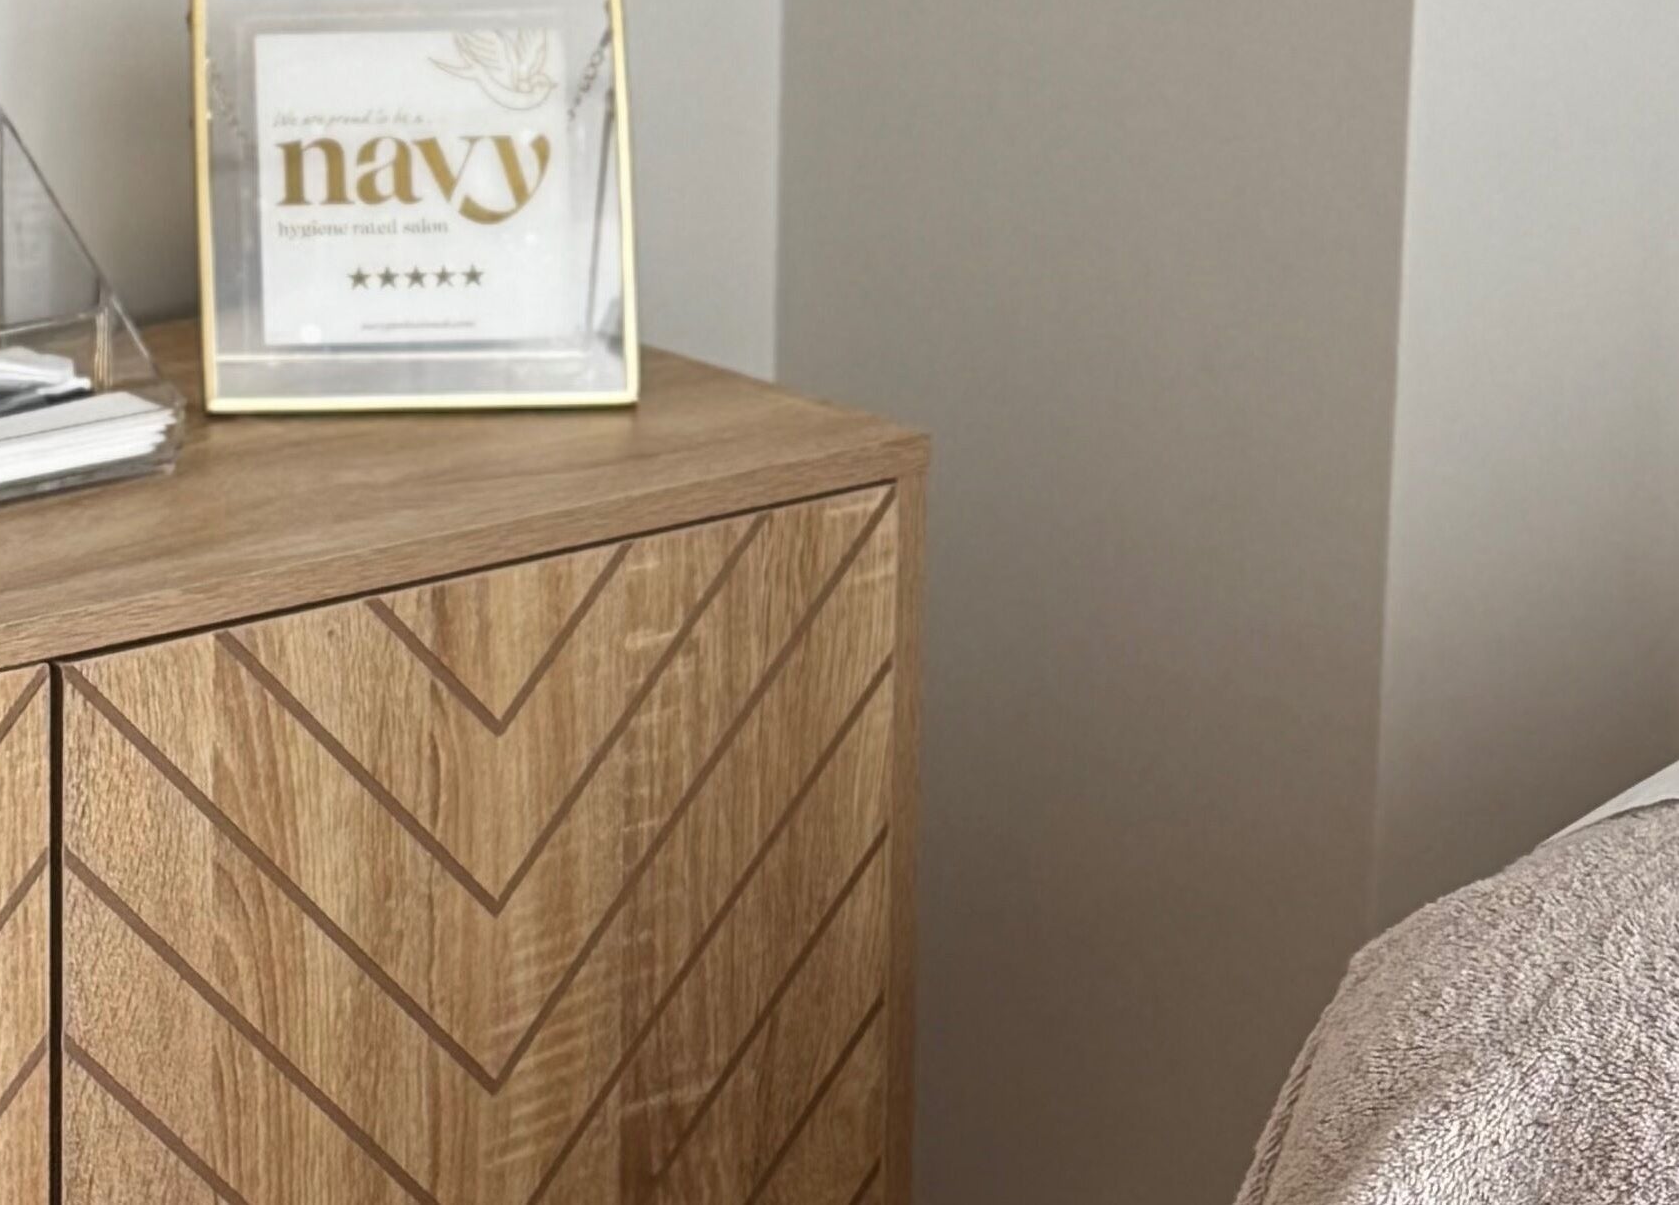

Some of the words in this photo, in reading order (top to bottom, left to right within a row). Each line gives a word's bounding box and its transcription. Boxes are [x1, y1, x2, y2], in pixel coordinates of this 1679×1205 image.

[275, 133, 551, 225] navy
[277, 219, 348, 241] hygiene
[351, 218, 398, 235] rated
[402, 216, 449, 235] salon
